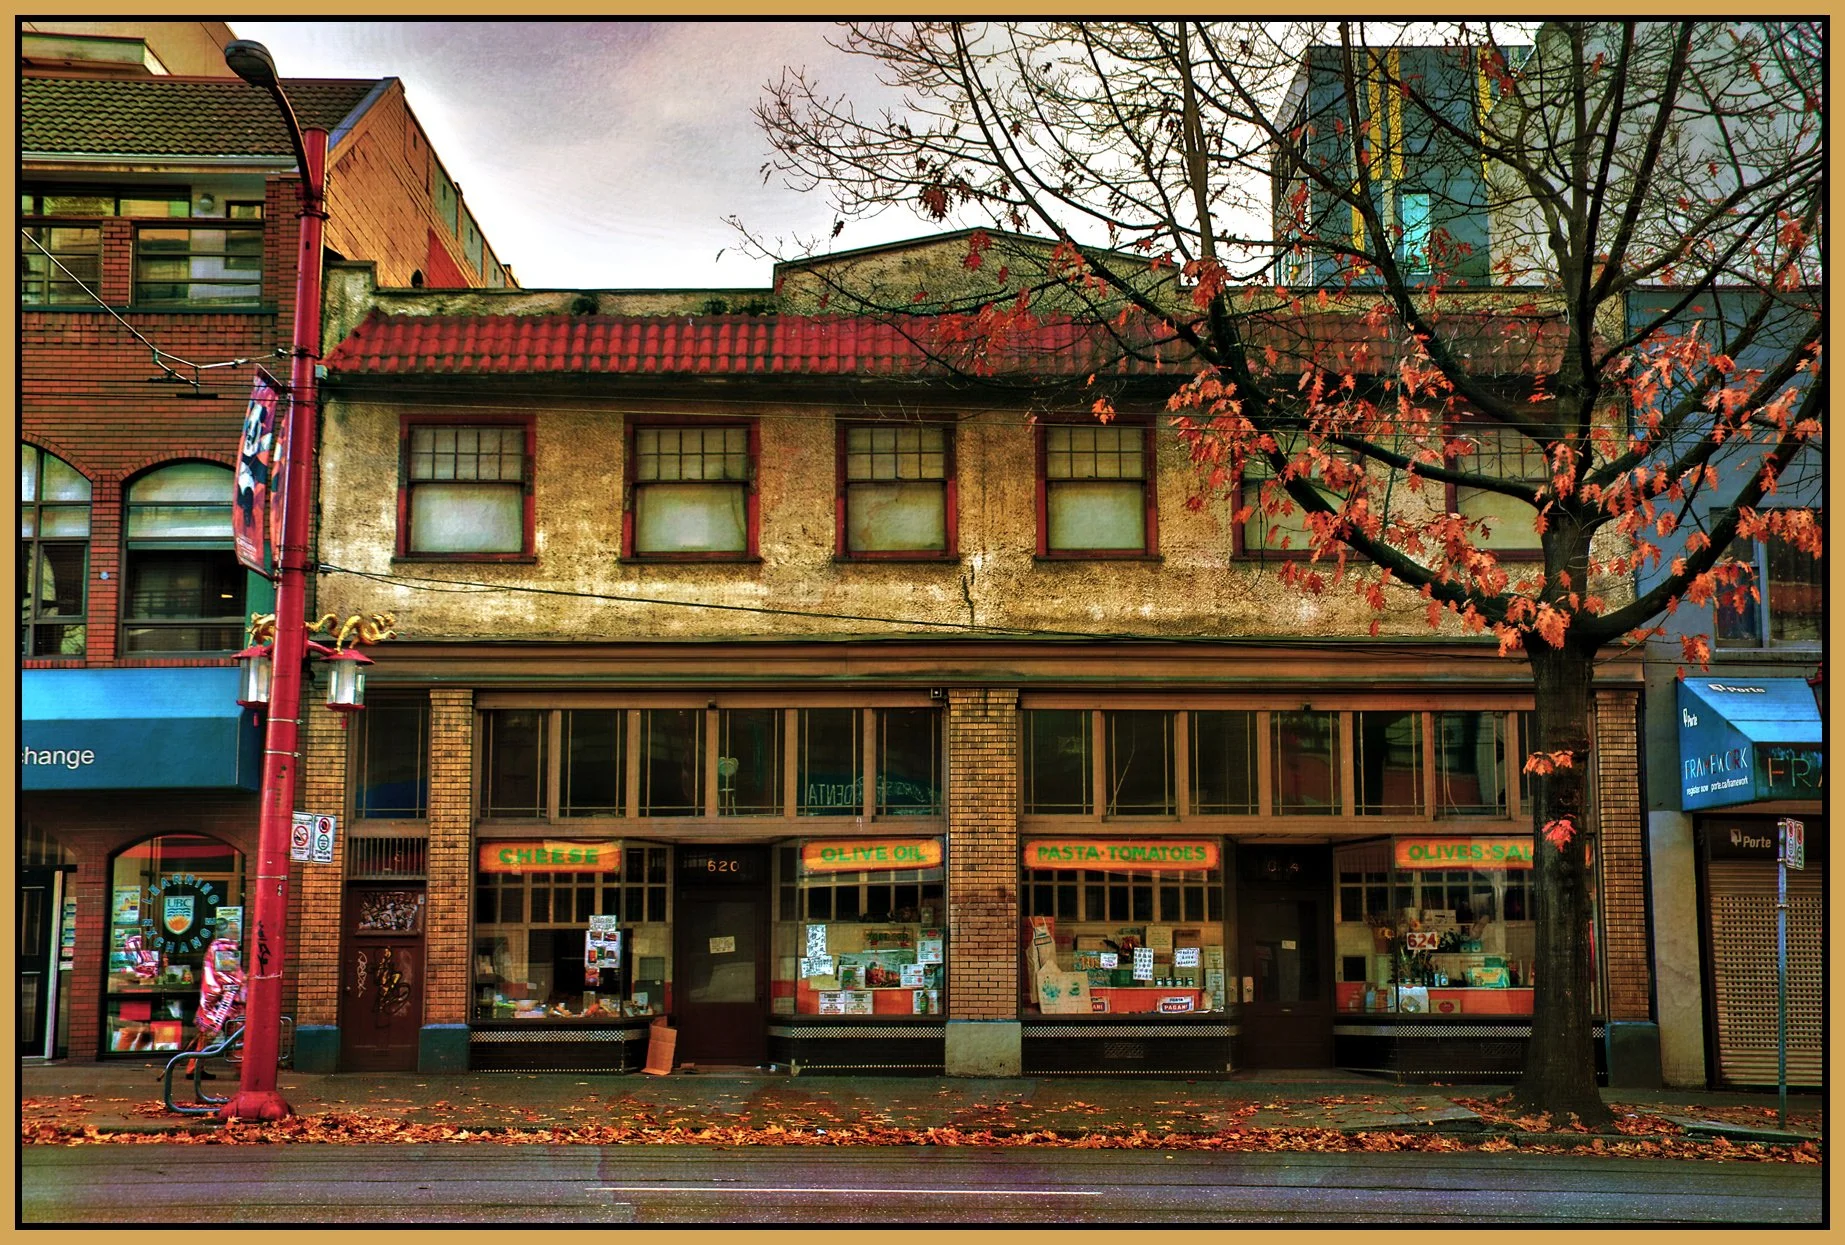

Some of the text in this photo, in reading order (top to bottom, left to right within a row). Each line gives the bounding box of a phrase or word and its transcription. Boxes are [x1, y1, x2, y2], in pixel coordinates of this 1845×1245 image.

[1728, 686, 1766, 694] Porte
[21, 746, 95, 770] hange
[1684, 747, 1748, 780] FRAMEWORK
[1768, 757, 1822, 788] FR
[1743, 835, 1772, 849] Porte
[498, 848, 599, 865] CHEESE
[821, 845, 928, 862] OLIVE OIL
[707, 860, 740, 872] 620
[167, 898, 191, 908] UBC
[1407, 933, 1437, 949] 624
